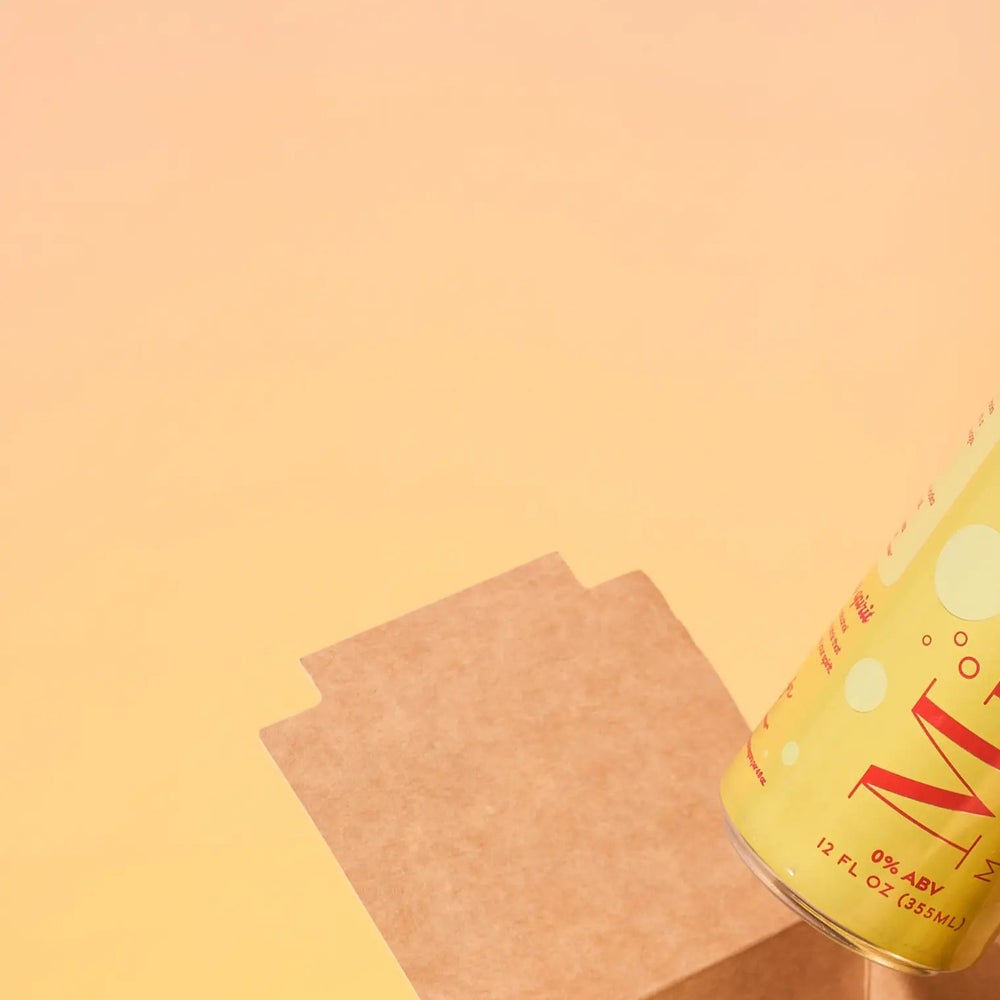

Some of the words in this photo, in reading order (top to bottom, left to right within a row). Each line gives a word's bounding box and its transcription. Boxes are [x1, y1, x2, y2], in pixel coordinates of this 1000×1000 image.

[816, 836, 835, 857] 12
[837, 853, 858, 878] FL
[866, 874, 895, 898] OZ
[897, 892, 966, 932] (355ML)
[870, 848, 901, 875] 0%
[900, 870, 945, 896] ABV
